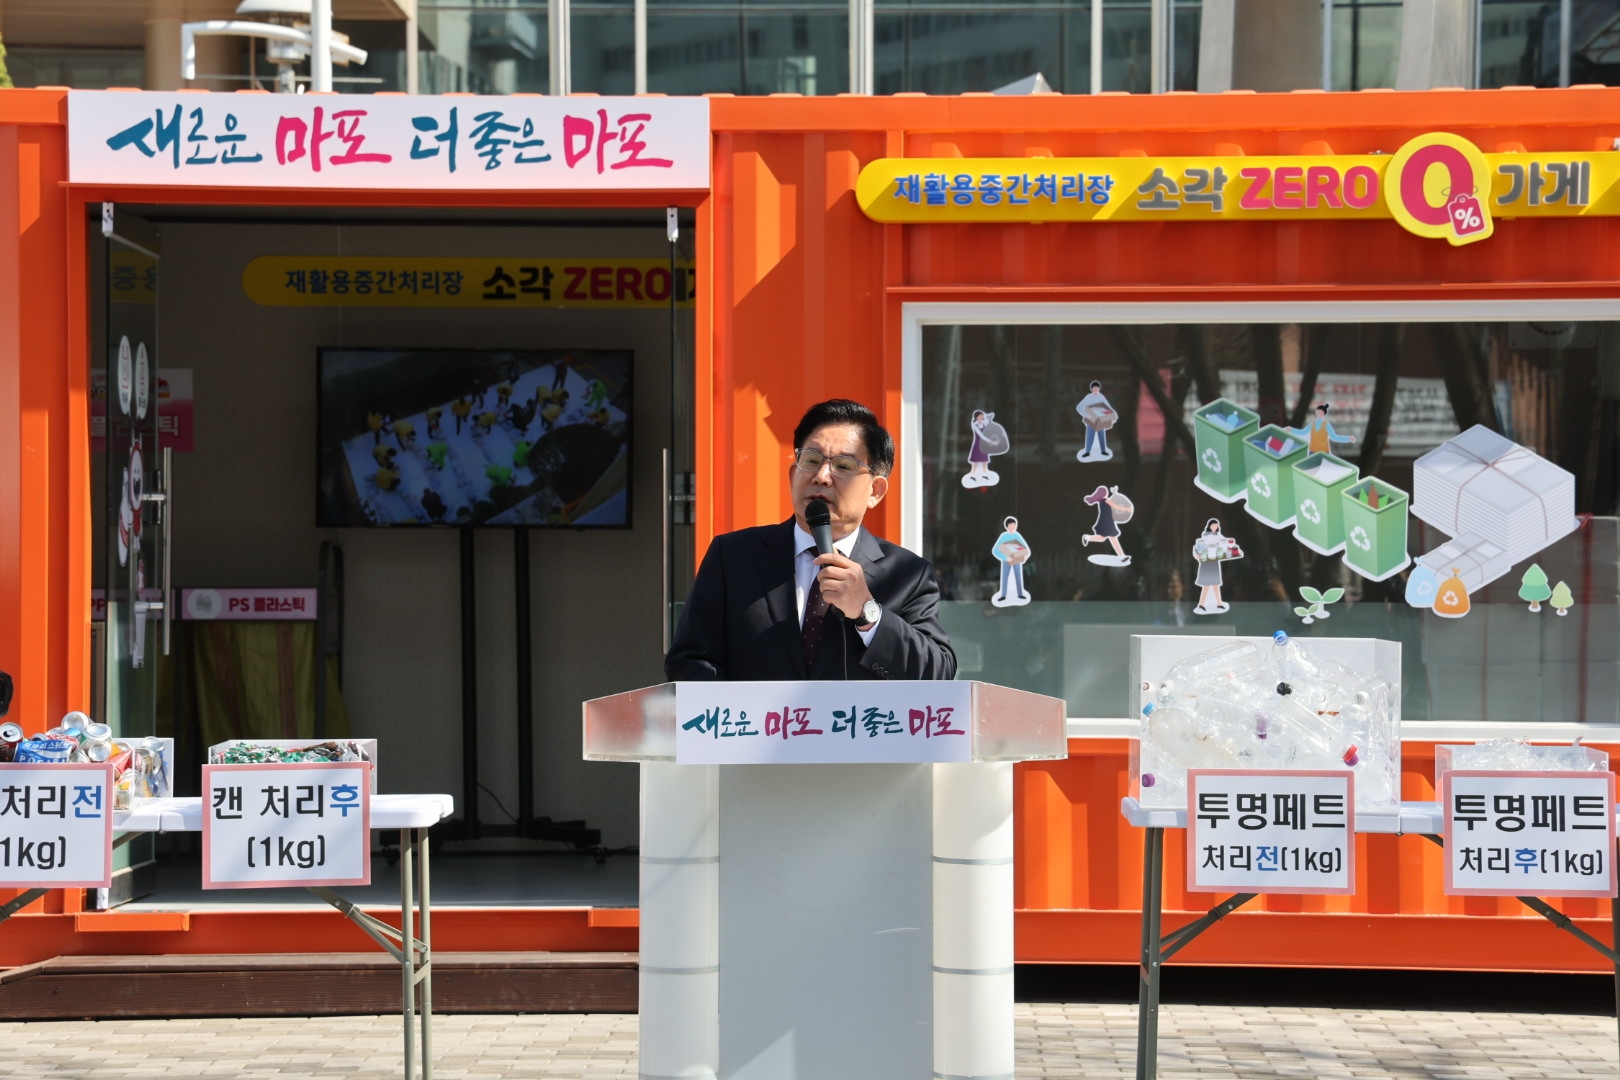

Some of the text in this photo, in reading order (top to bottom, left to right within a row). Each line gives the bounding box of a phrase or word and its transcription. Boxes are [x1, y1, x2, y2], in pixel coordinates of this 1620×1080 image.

[106, 104, 674, 175] 새로운 마포 더 좋은 마포
[894, 173, 1115, 206] 재활용중간처리장
[1137, 166, 1228, 212] 소각
[1239, 165, 1380, 209] ZERO
[1497, 161, 1591, 206] 가게
[285, 269, 464, 295] 재활용중간처리장
[483, 266, 554, 301] 소각
[563, 266, 673, 301] ZERO
[229, 597, 305, 612] PS 플라스틱
[682, 705, 966, 740] 새로운 마포 더 좋은 마포
[0, 785, 102, 819] 처리전
[212, 784, 360, 820] 캔 처리후
[1197, 793, 1346, 831] 투명페트
[1453, 795, 1607, 833] 투명페트
[247, 834, 326, 869] (1kg)
